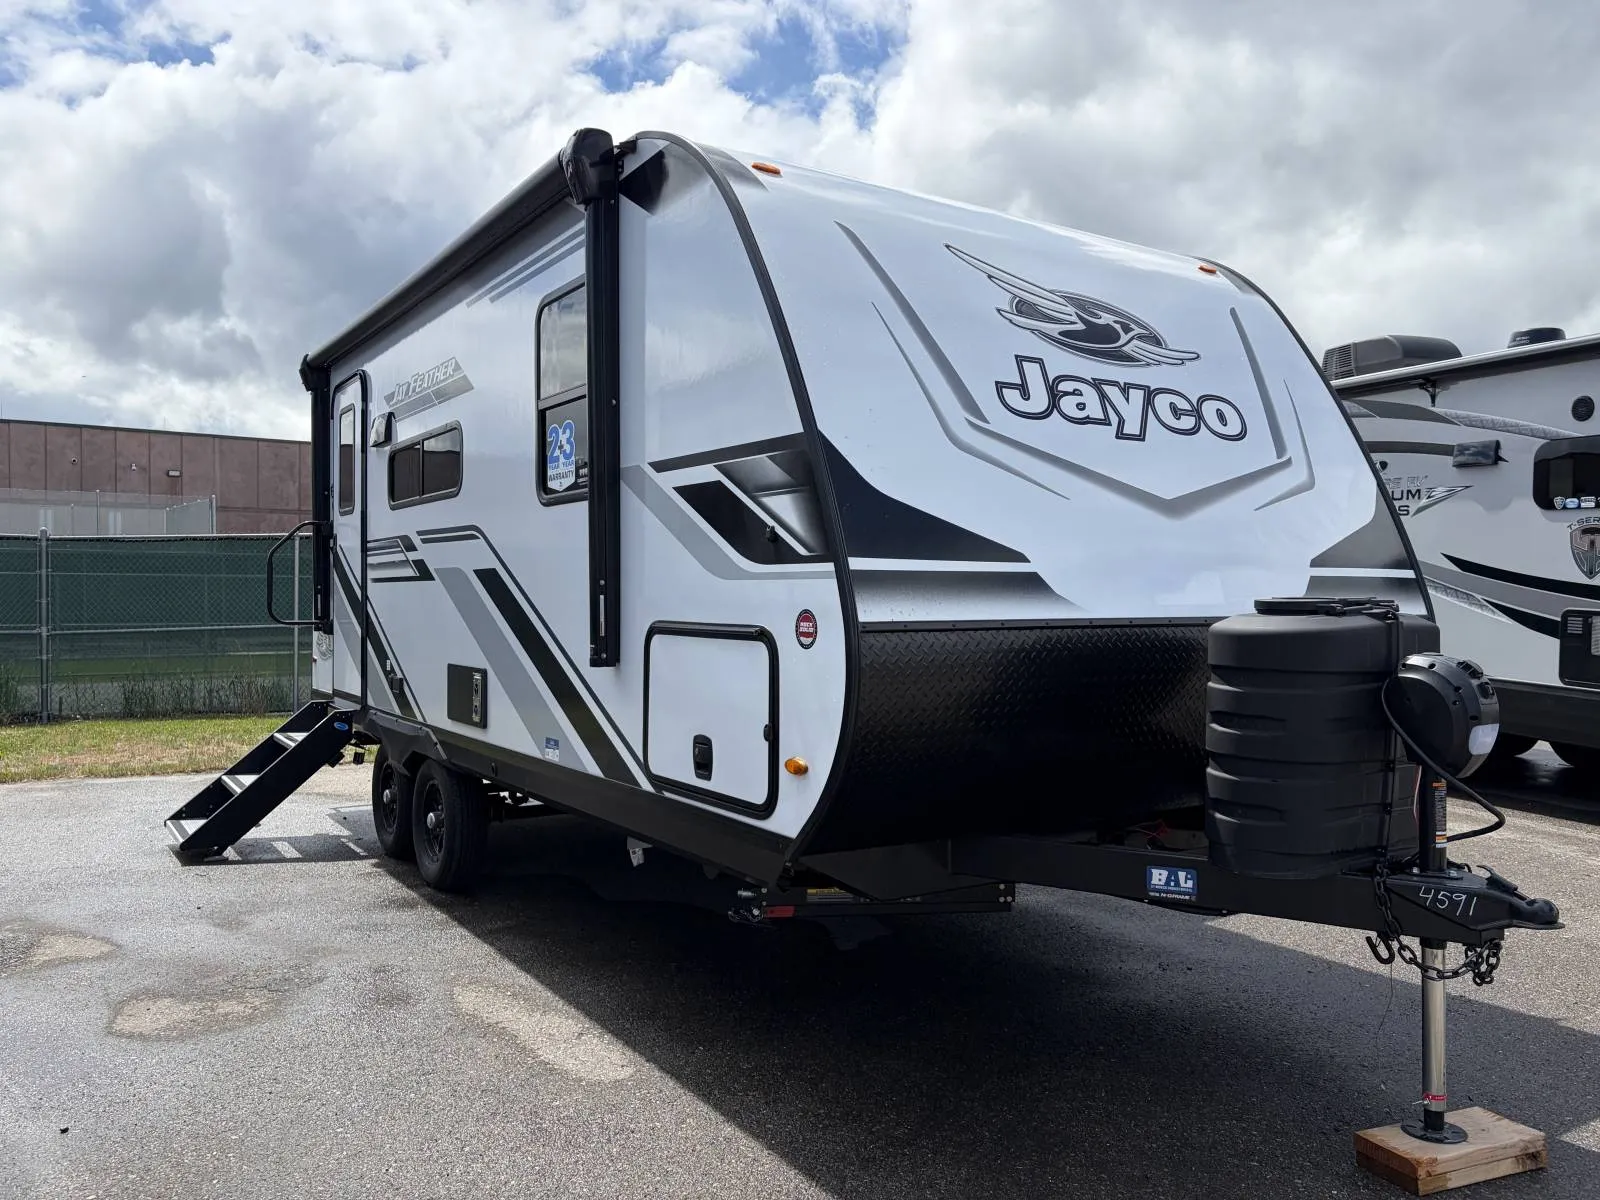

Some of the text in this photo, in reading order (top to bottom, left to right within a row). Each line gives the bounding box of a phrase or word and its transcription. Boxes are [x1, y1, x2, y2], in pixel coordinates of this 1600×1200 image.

[408, 359, 455, 396] FEATHER
[995, 354, 1247, 441] Jayco
[549, 470, 575, 482] WARRANTY
[1419, 885, 1477, 916] 4591
